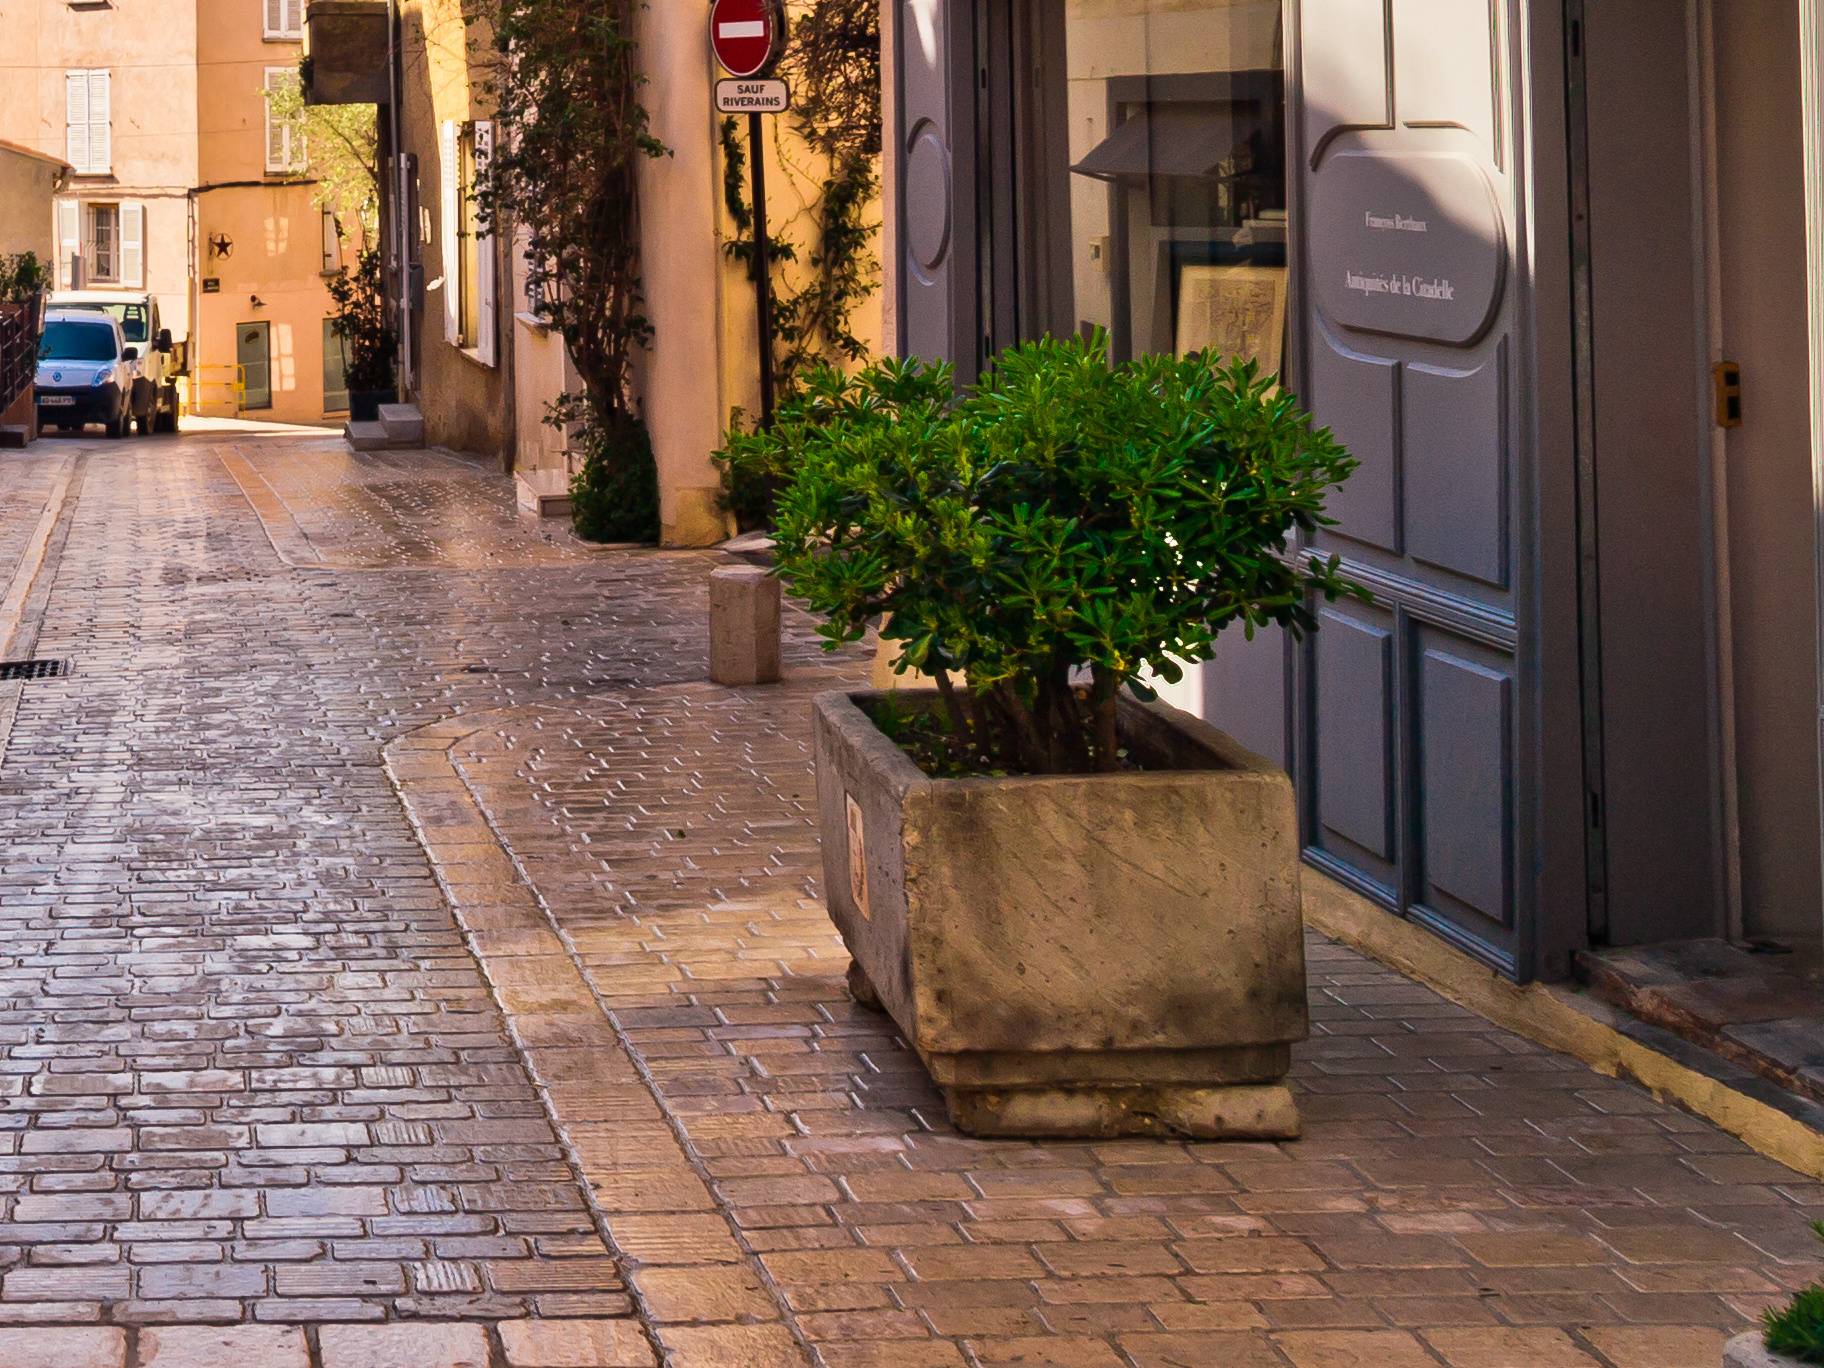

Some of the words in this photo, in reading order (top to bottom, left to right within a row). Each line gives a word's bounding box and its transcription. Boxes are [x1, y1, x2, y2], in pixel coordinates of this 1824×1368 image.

[737, 84, 765, 94] SAUF
[722, 96, 781, 107] RIVERAINS
[1389, 273, 1401, 294] de
[1402, 275, 1412, 296] la
[1412, 276, 1454, 300] Citadelle
